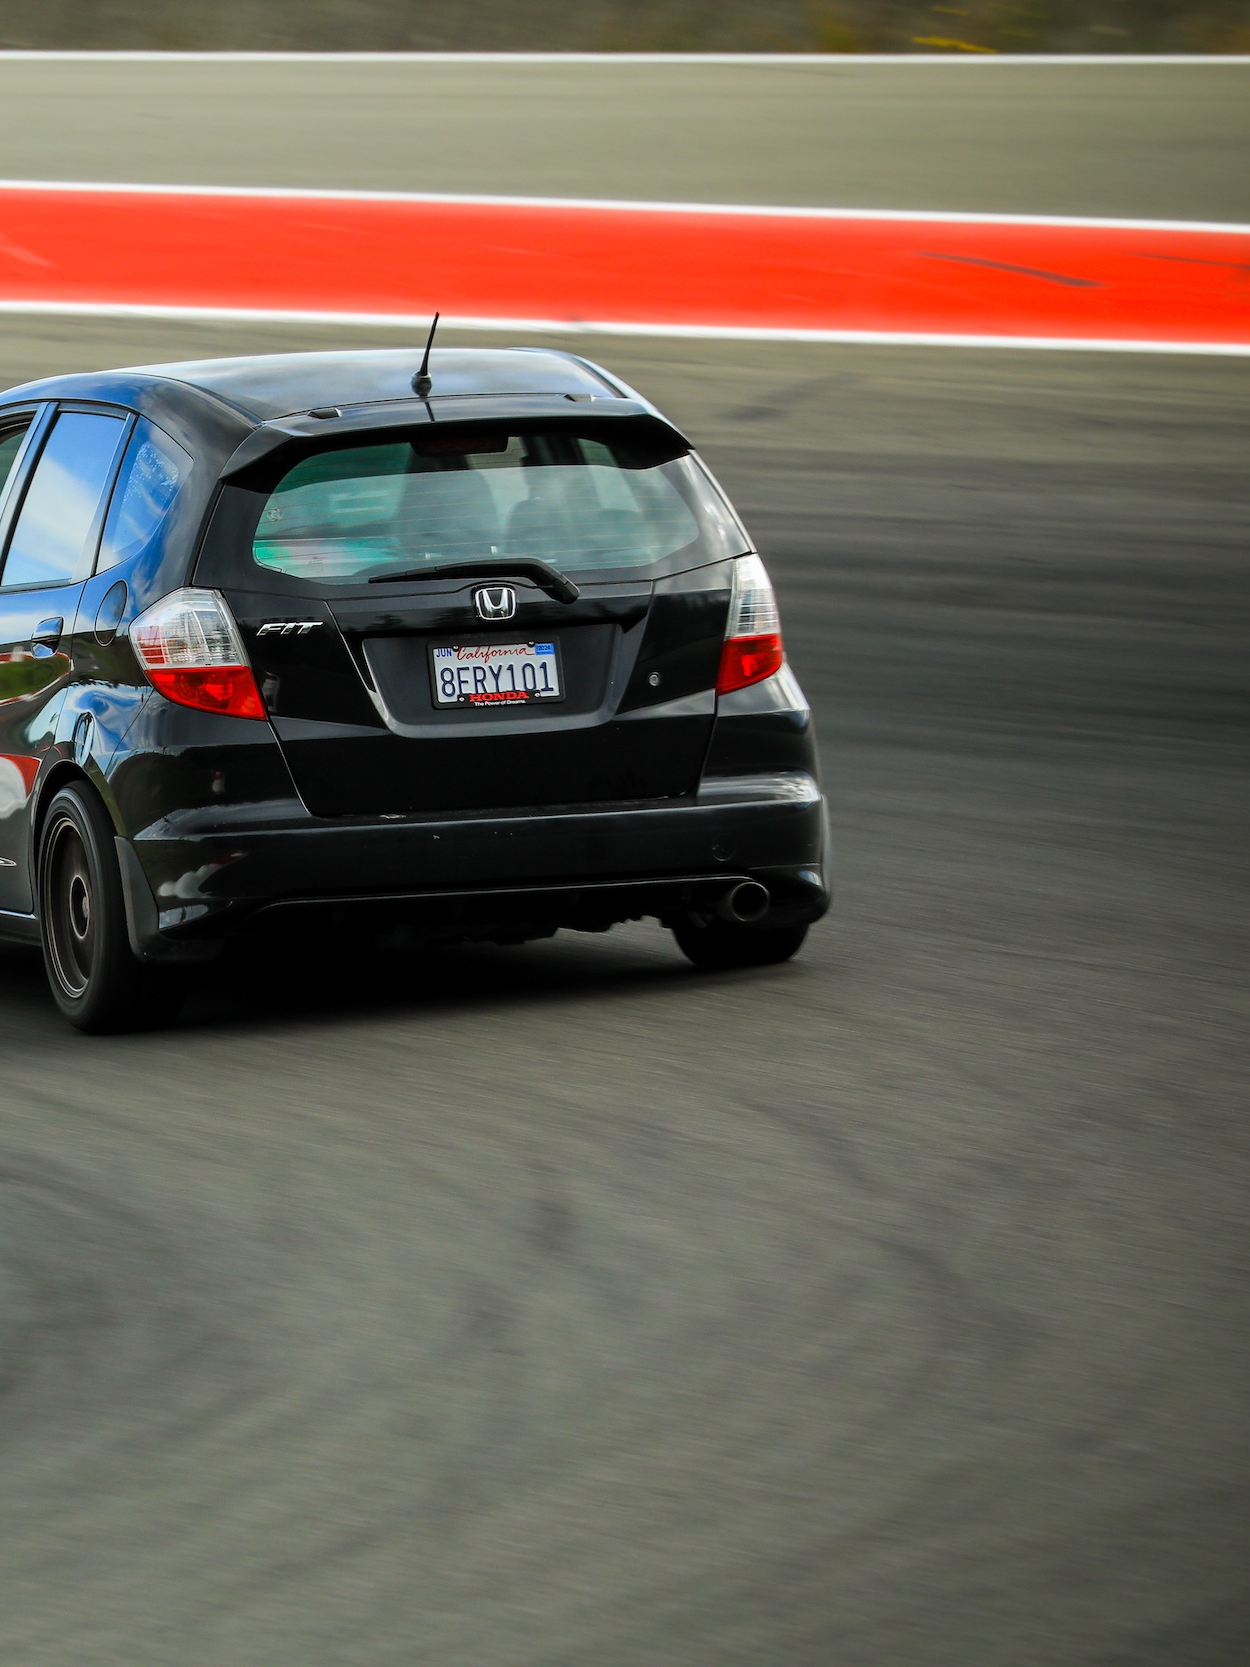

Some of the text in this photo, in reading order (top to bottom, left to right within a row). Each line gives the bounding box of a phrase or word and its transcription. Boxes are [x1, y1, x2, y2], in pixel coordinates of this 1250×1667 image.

[256, 621, 324, 636] FIT
[436, 648, 452, 658] JUN
[456, 645, 536, 663] California
[469, 691, 529, 702] HONDA
